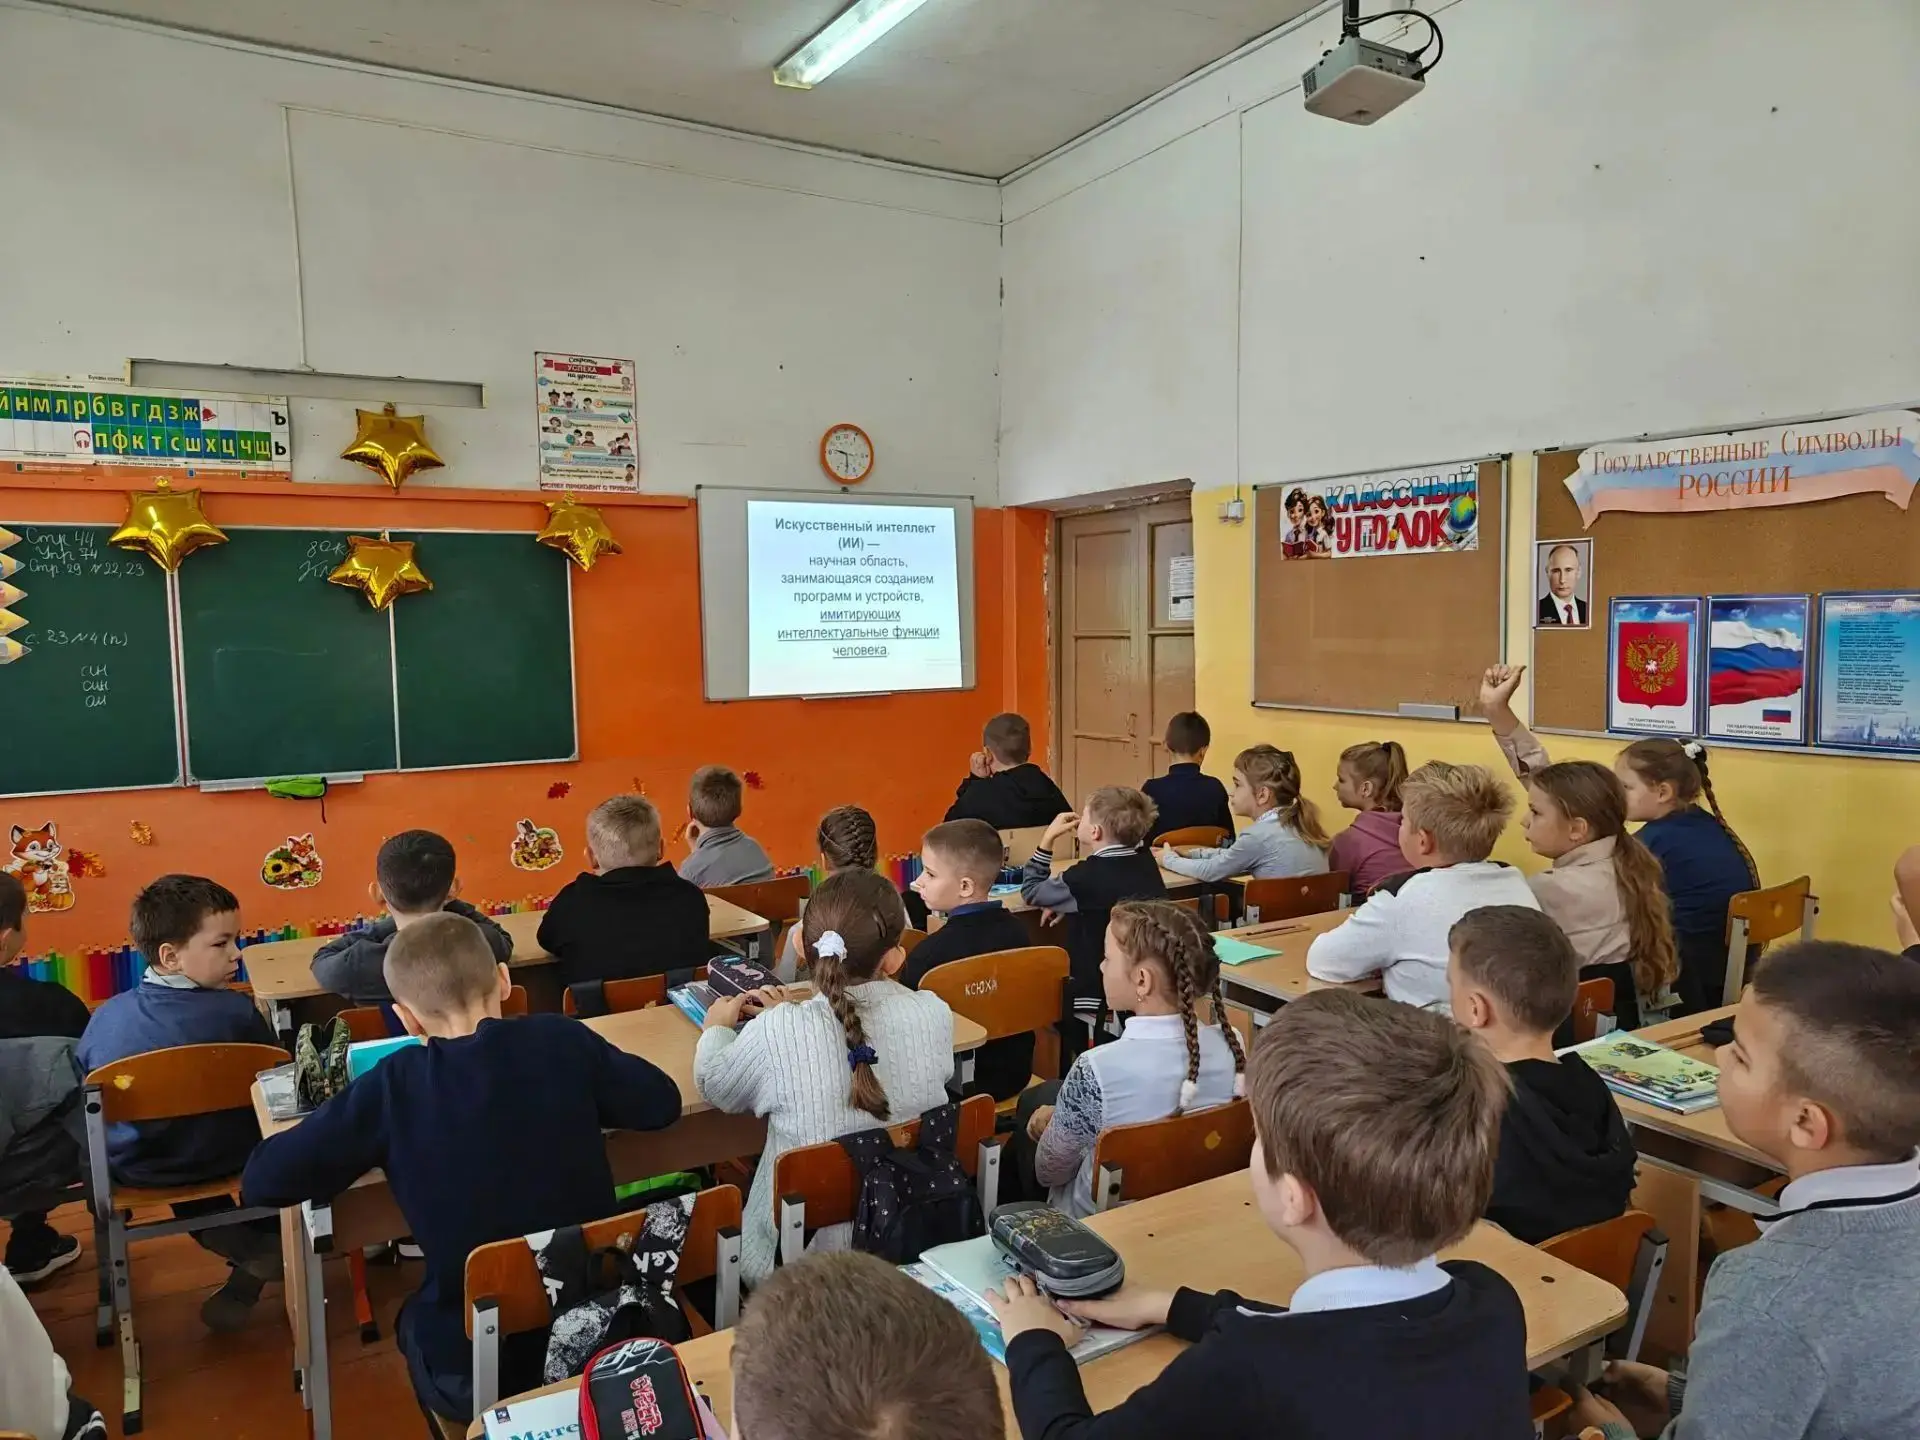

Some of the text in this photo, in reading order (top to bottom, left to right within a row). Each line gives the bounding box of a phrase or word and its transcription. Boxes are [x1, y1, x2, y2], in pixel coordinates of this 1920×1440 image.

[567, 365, 598, 373] УСПЕХА
[1678, 465, 1795, 500] РОССИИ
[1325, 471, 1477, 513] КЛАССНЫЙ
[775, 517, 936, 533] Искусственный интеллект
[1336, 508, 1452, 552] УГОЛОК
[75, 531, 95, 547] 44
[838, 537, 864, 551] (ИИ)
[80, 547, 97, 560] 74
[809, 555, 908, 568] научная область,
[67, 563, 82, 576] 29
[781, 573, 934, 585] занимающаяся созданием
[793, 590, 924, 604] программ и устройств,
[820, 609, 901, 622] имитирующих
[47, 629, 69, 644] 23
[778, 625, 940, 641] интеллектуальные функции
[833, 645, 890, 658] человека.
[508, 1423, 580, 1440] Мате
